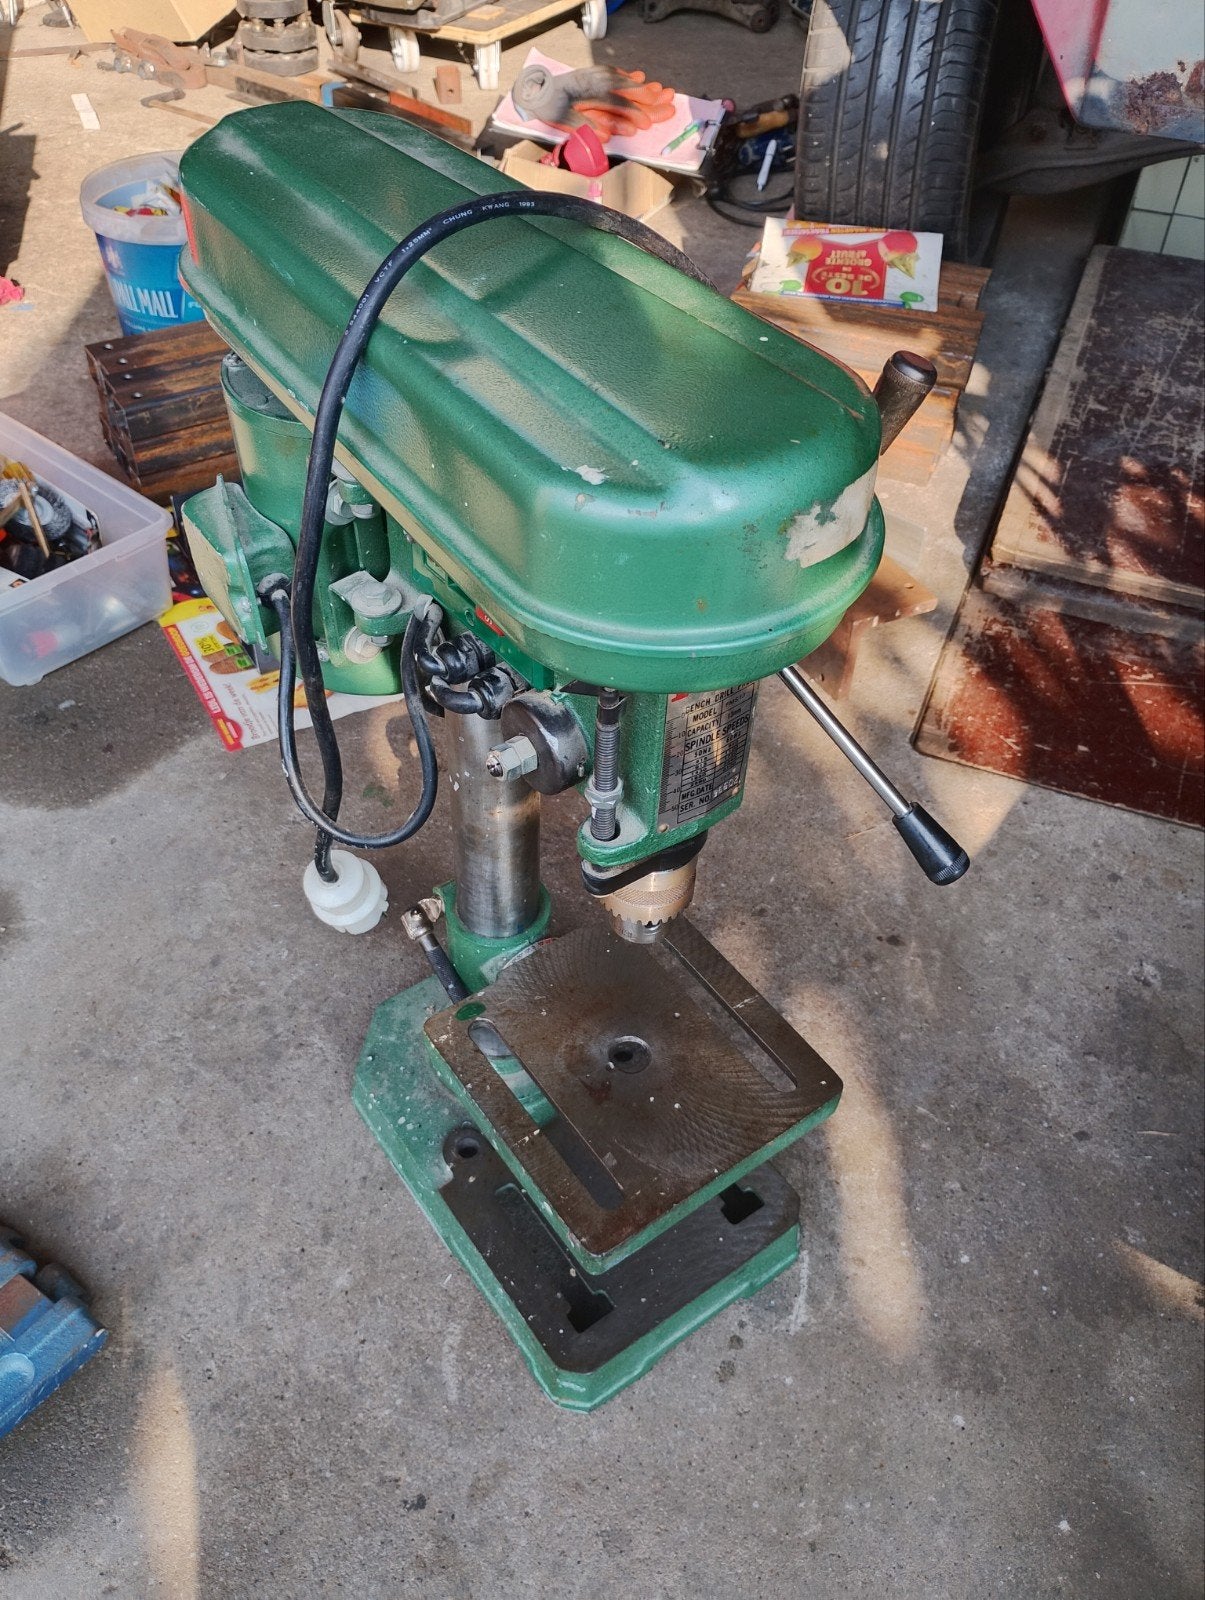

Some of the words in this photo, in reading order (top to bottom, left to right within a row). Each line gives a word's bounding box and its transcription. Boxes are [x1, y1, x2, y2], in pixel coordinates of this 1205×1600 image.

[374, 259, 393, 283] VCTF
[443, 210, 473, 225] CHUNG
[481, 202, 510, 211] KWANG
[825, 278, 868, 296] 10
[136, 287, 179, 318] MALL
[715, 686, 733, 702] DRILL
[693, 708, 717, 722] MODEL
[685, 732, 719, 751] SPINDLE
[723, 714, 749, 735] SPEEDS
[688, 719, 719, 737] CAPACITY
